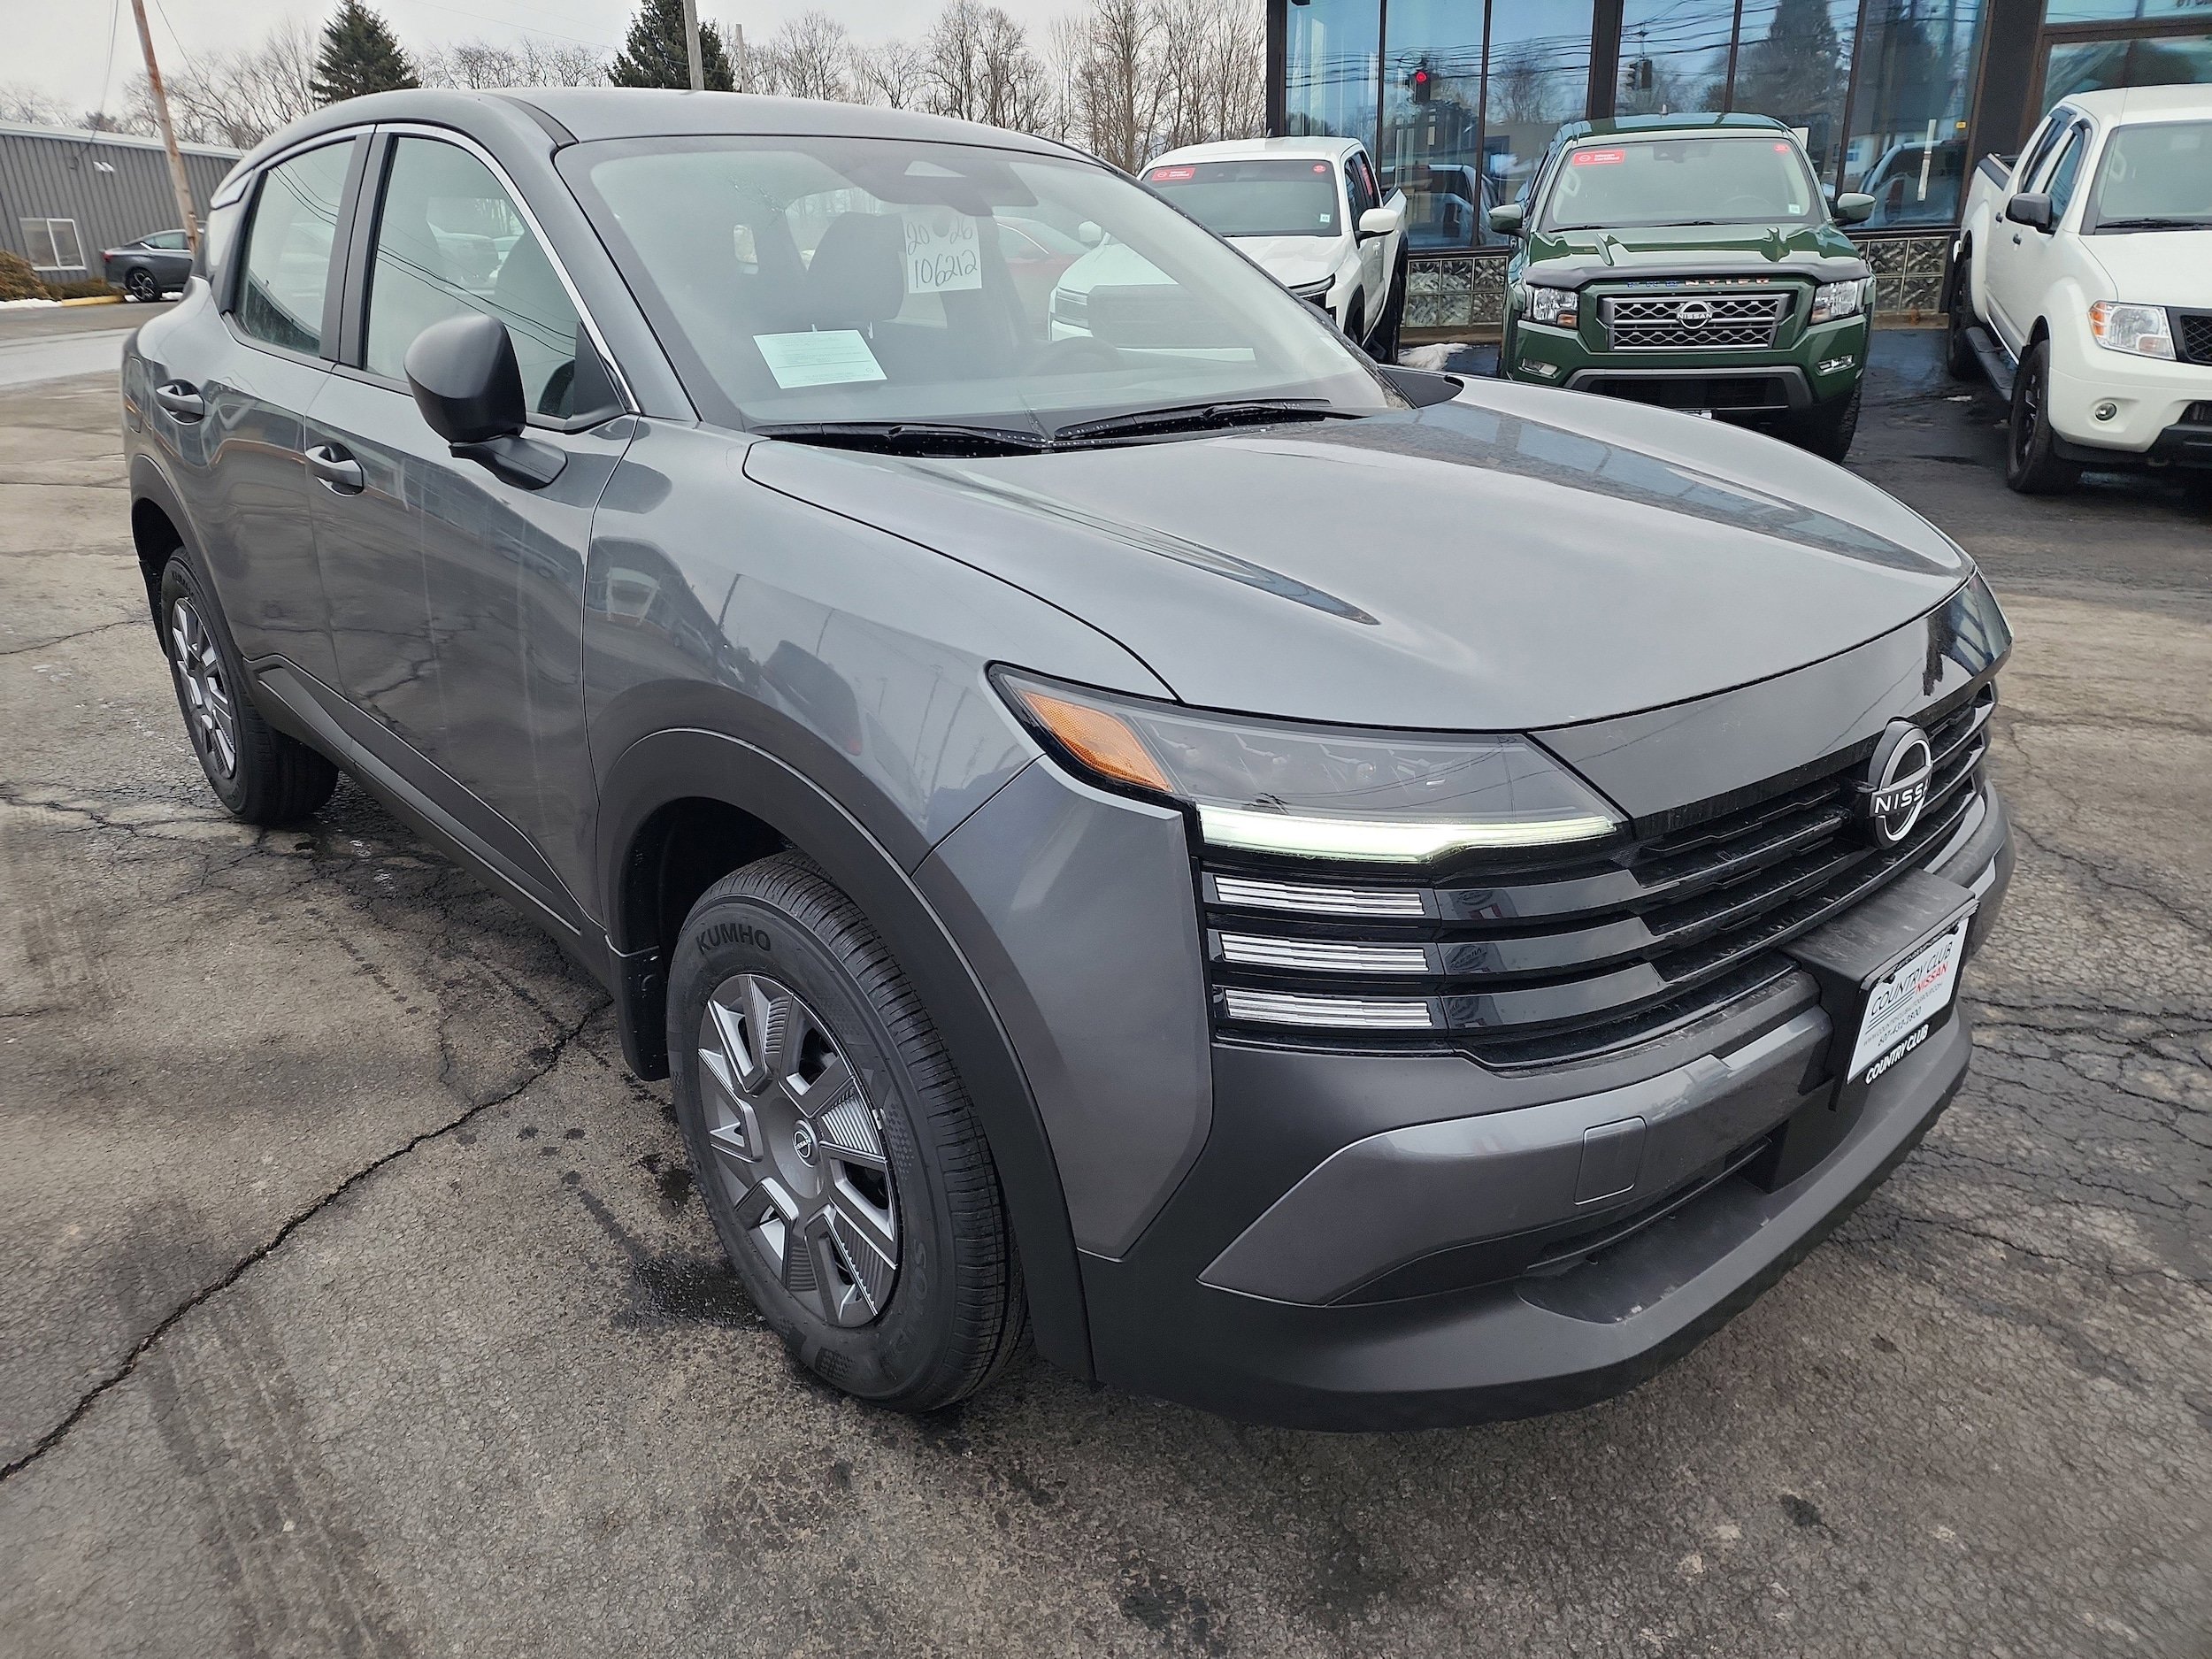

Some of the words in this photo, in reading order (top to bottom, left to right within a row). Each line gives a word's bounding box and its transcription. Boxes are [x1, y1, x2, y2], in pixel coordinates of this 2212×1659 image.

[914, 249, 978, 288] 106212
[695, 922, 772, 956] KUMHO
[1870, 960, 1928, 1017] COUNTRY
[1926, 941, 1953, 973] CLUB
[1915, 961, 1949, 995] NISSAN
[1865, 1038, 1909, 1084] COUNTRY
[1906, 1024, 1929, 1052] CLUB
